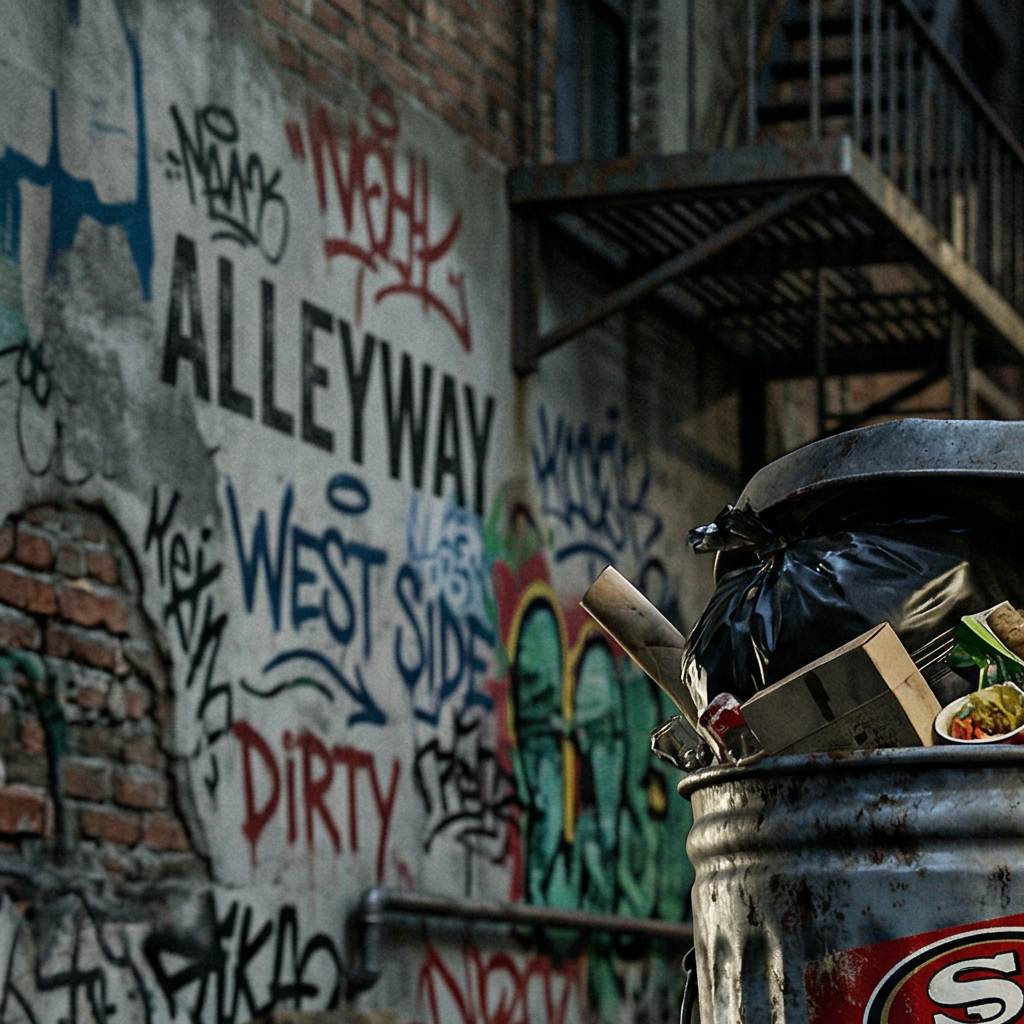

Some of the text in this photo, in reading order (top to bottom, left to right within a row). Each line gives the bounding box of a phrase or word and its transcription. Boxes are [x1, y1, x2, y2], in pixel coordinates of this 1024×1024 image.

[161, 233, 496, 518] ALLEYWAY
[225, 475, 387, 662] WEST
[394, 563, 496, 712] SIDE
